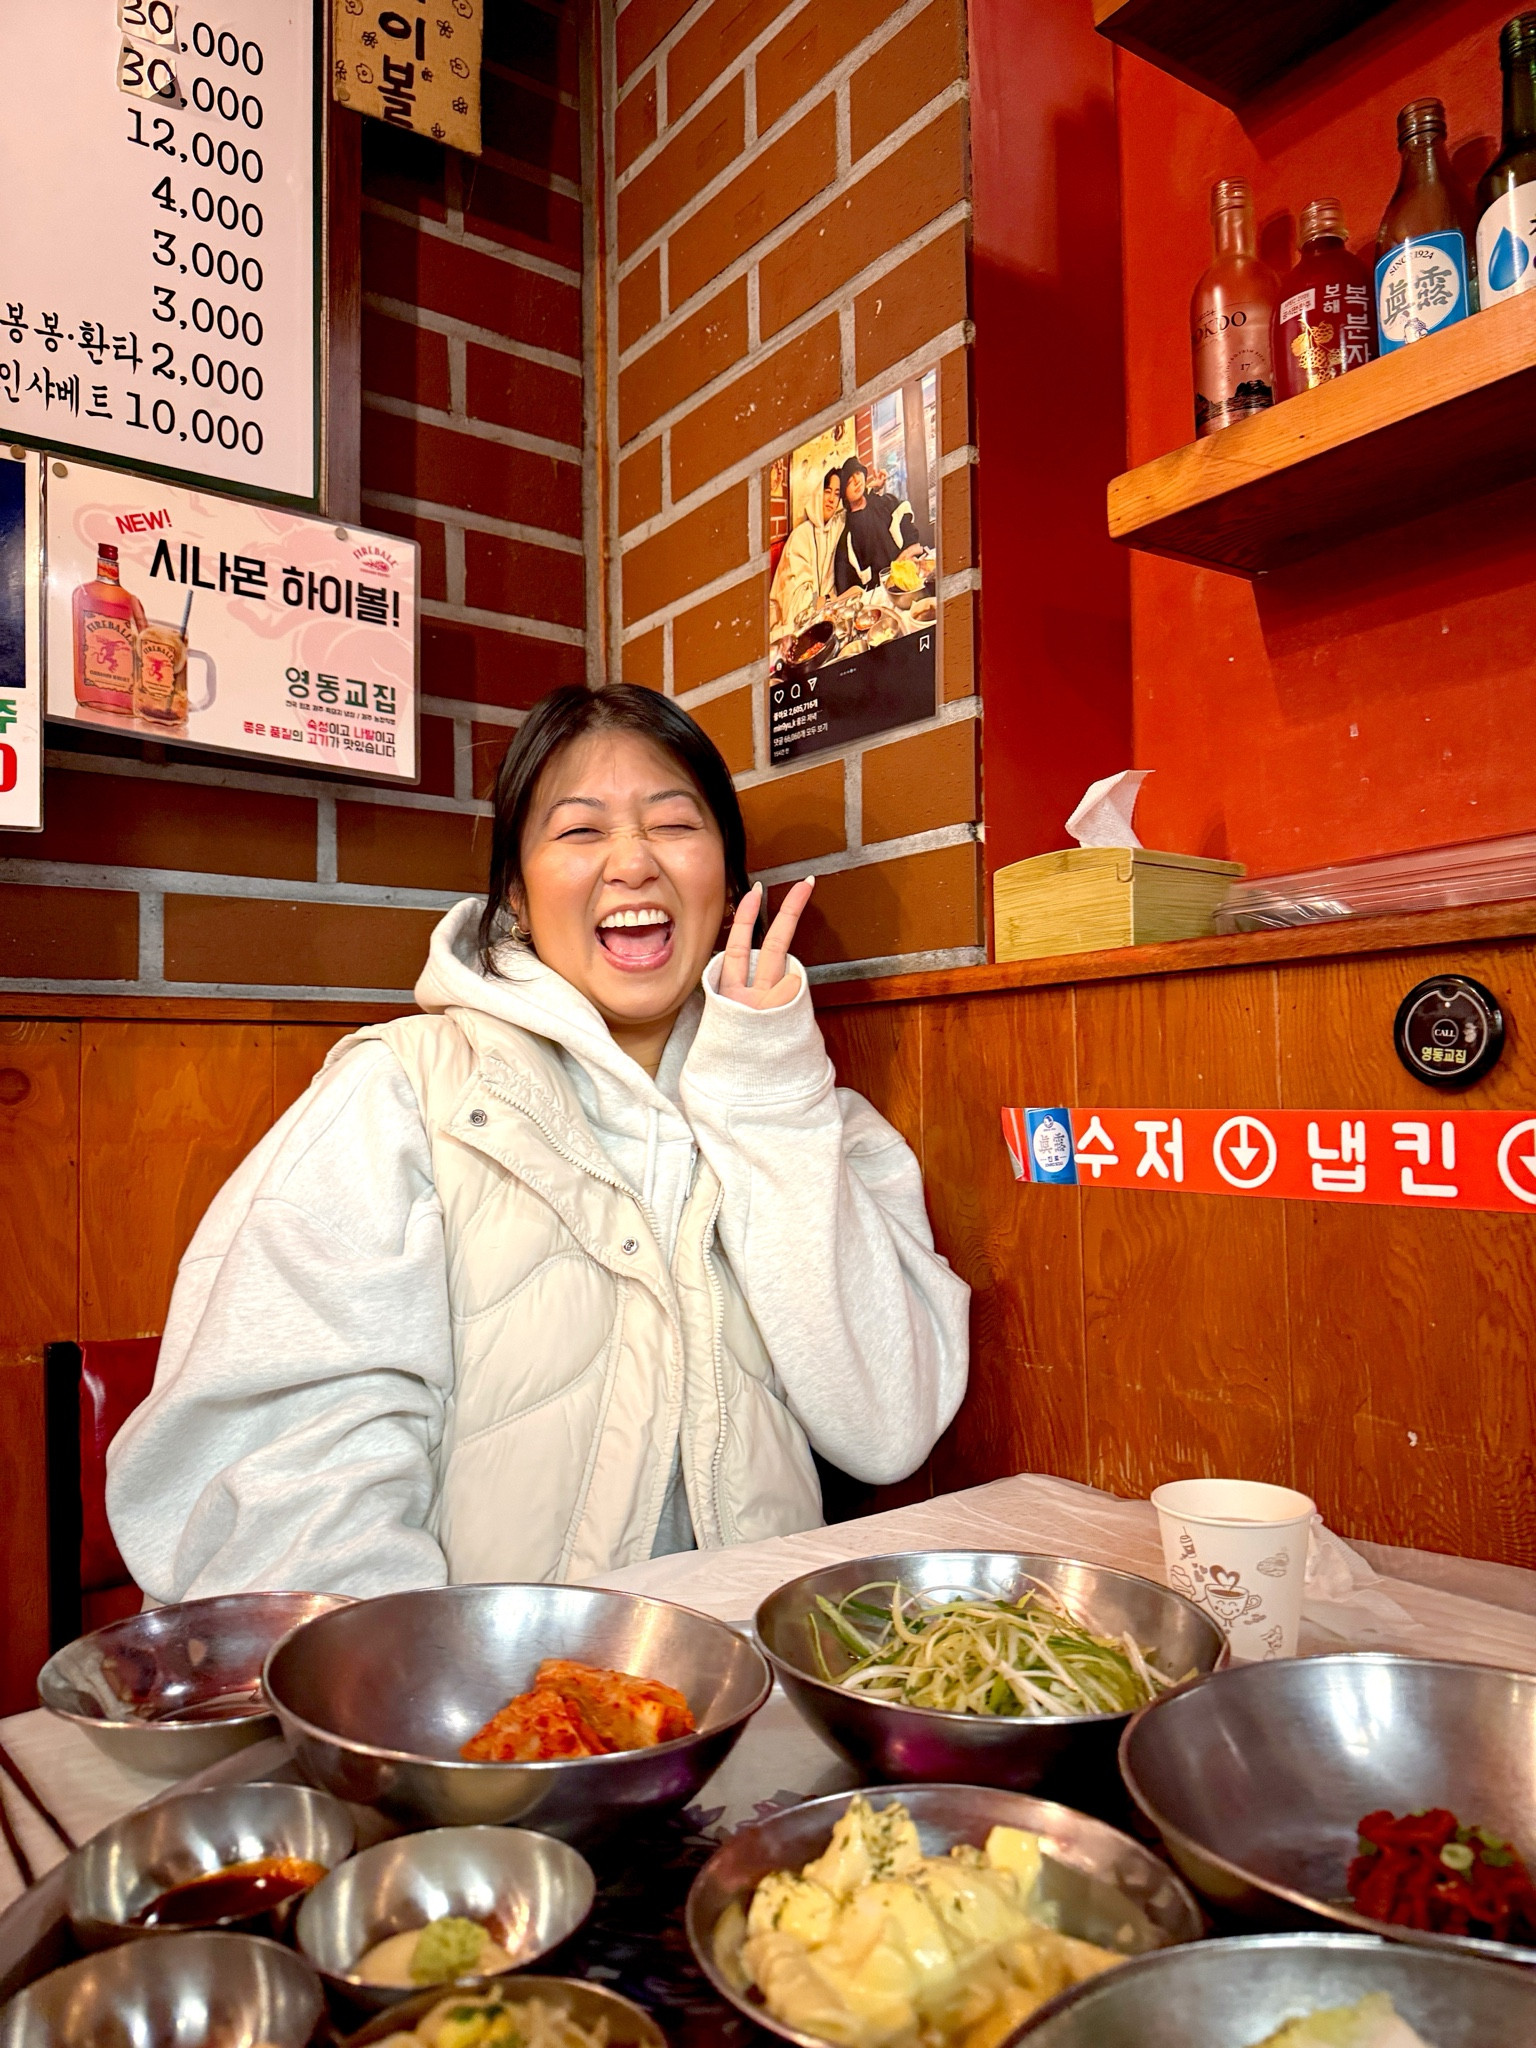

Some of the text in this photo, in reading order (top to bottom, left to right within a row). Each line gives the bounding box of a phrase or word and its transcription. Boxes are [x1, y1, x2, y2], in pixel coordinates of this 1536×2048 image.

[124, 0, 263, 75] 30,000
[377, 0, 426, 130] 이볼
[123, 46, 263, 129] 30,000
[128, 108, 263, 183] 12,000
[152, 177, 263, 238] 4,000
[153, 229, 263, 292] 3,000
[1389, 250, 1434, 276] SINC 1924
[153, 286, 263, 347] 3,000
[1323, 283, 1341, 314] 보해
[1344, 284, 1372, 363] 복분자
[153, 343, 263, 401] 2,000
[126, 392, 263, 456] 10,000
[116, 509, 173, 534] NEW!
[150, 539, 400, 628] 시나몬 하이볼!
[285, 667, 396, 714] 영동교집
[243, 721, 396, 758] 좋은 품질의 고기가 맛있습니다
[307, 719, 395, 745] 숙성이고 나발이고
[1421, 1046, 1467, 1064] 영동교집
[1434, 1029, 1456, 1037] CALL
[1074, 1115, 1458, 1198] 수저 냅킨
